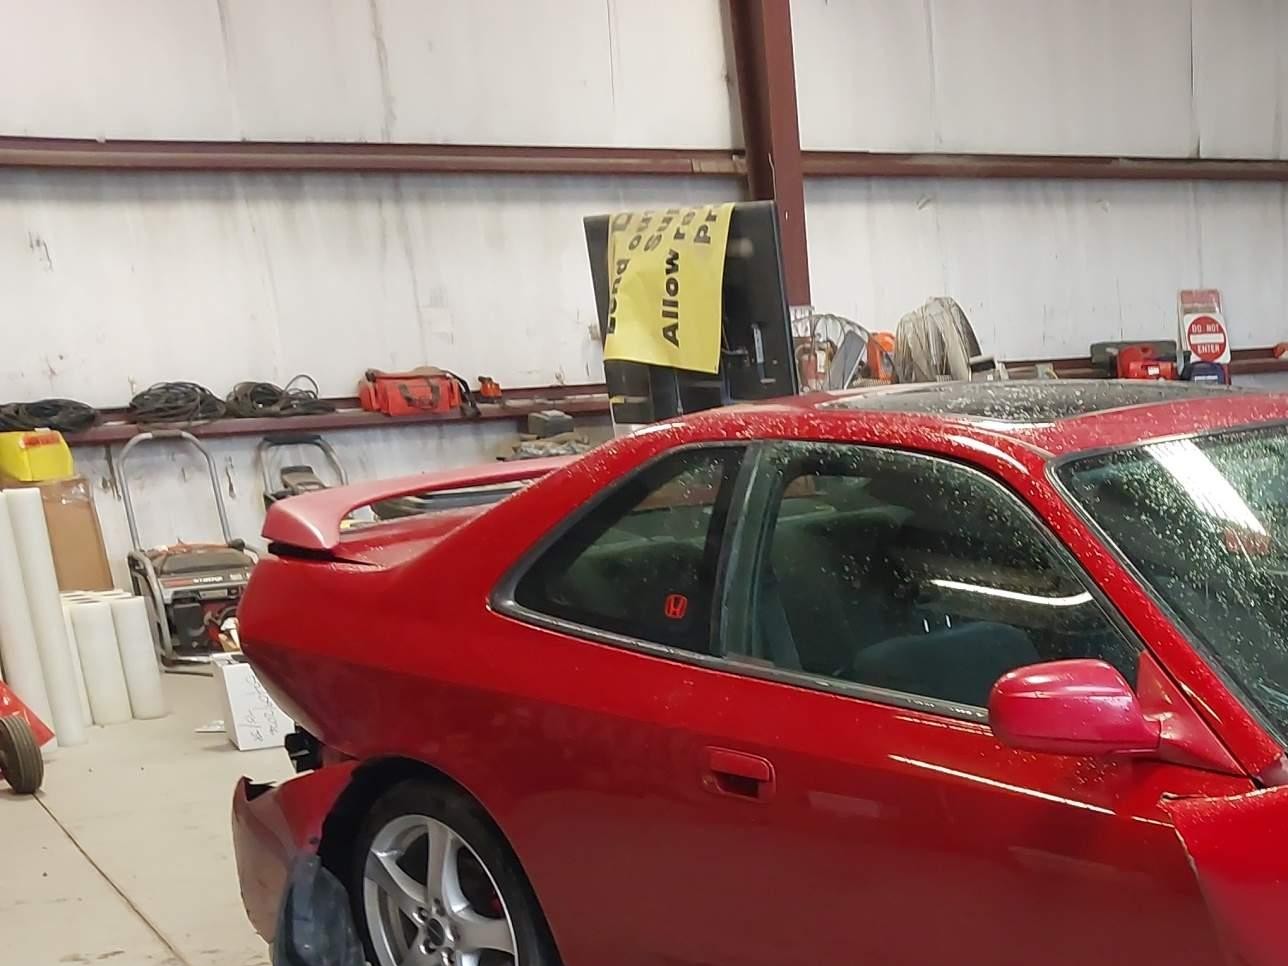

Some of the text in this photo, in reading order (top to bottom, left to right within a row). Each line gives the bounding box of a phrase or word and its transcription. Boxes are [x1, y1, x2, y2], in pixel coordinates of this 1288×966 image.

[661, 248, 680, 348] Allow
[1191, 323, 1219, 333] DO NOT
[1197, 343, 1220, 353] ENTER
